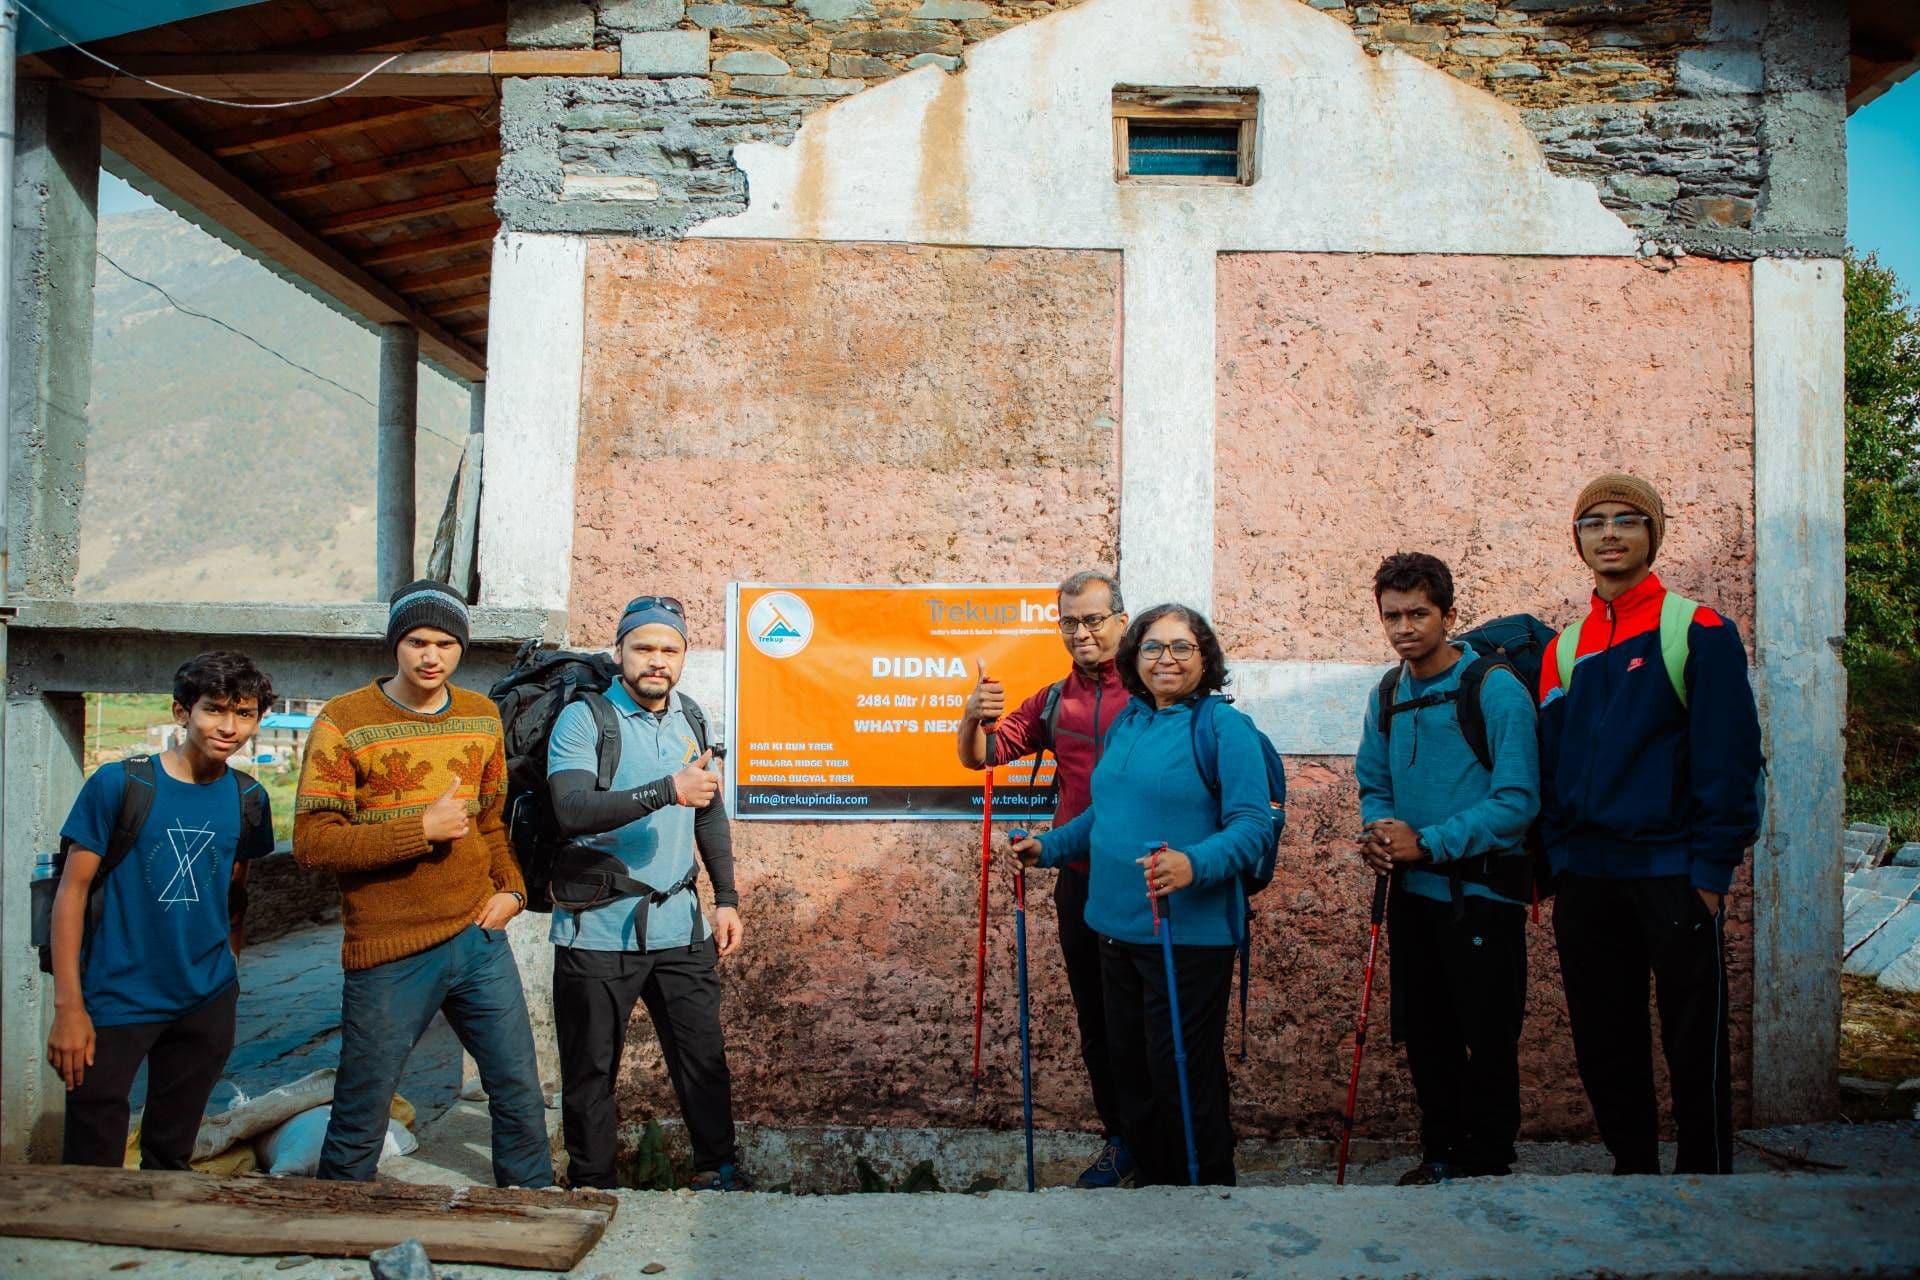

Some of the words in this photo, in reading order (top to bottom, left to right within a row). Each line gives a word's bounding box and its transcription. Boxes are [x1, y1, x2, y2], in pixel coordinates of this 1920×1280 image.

[872, 657, 967, 678] DIDNA
[857, 695, 890, 708] 2484
[894, 695, 918, 708] Mtr
[929, 695, 963, 707] 8150
[854, 720, 918, 732] WHAT'S
[924, 720, 962, 732] NEX
[808, 742, 833, 751] TREK
[795, 759, 822, 767] RIDGE
[825, 759, 849, 767] TREK
[789, 774, 826, 783] BUGYAL
[829, 774, 854, 783] TREK
[749, 794, 868, 806] info@trekupindia.com
